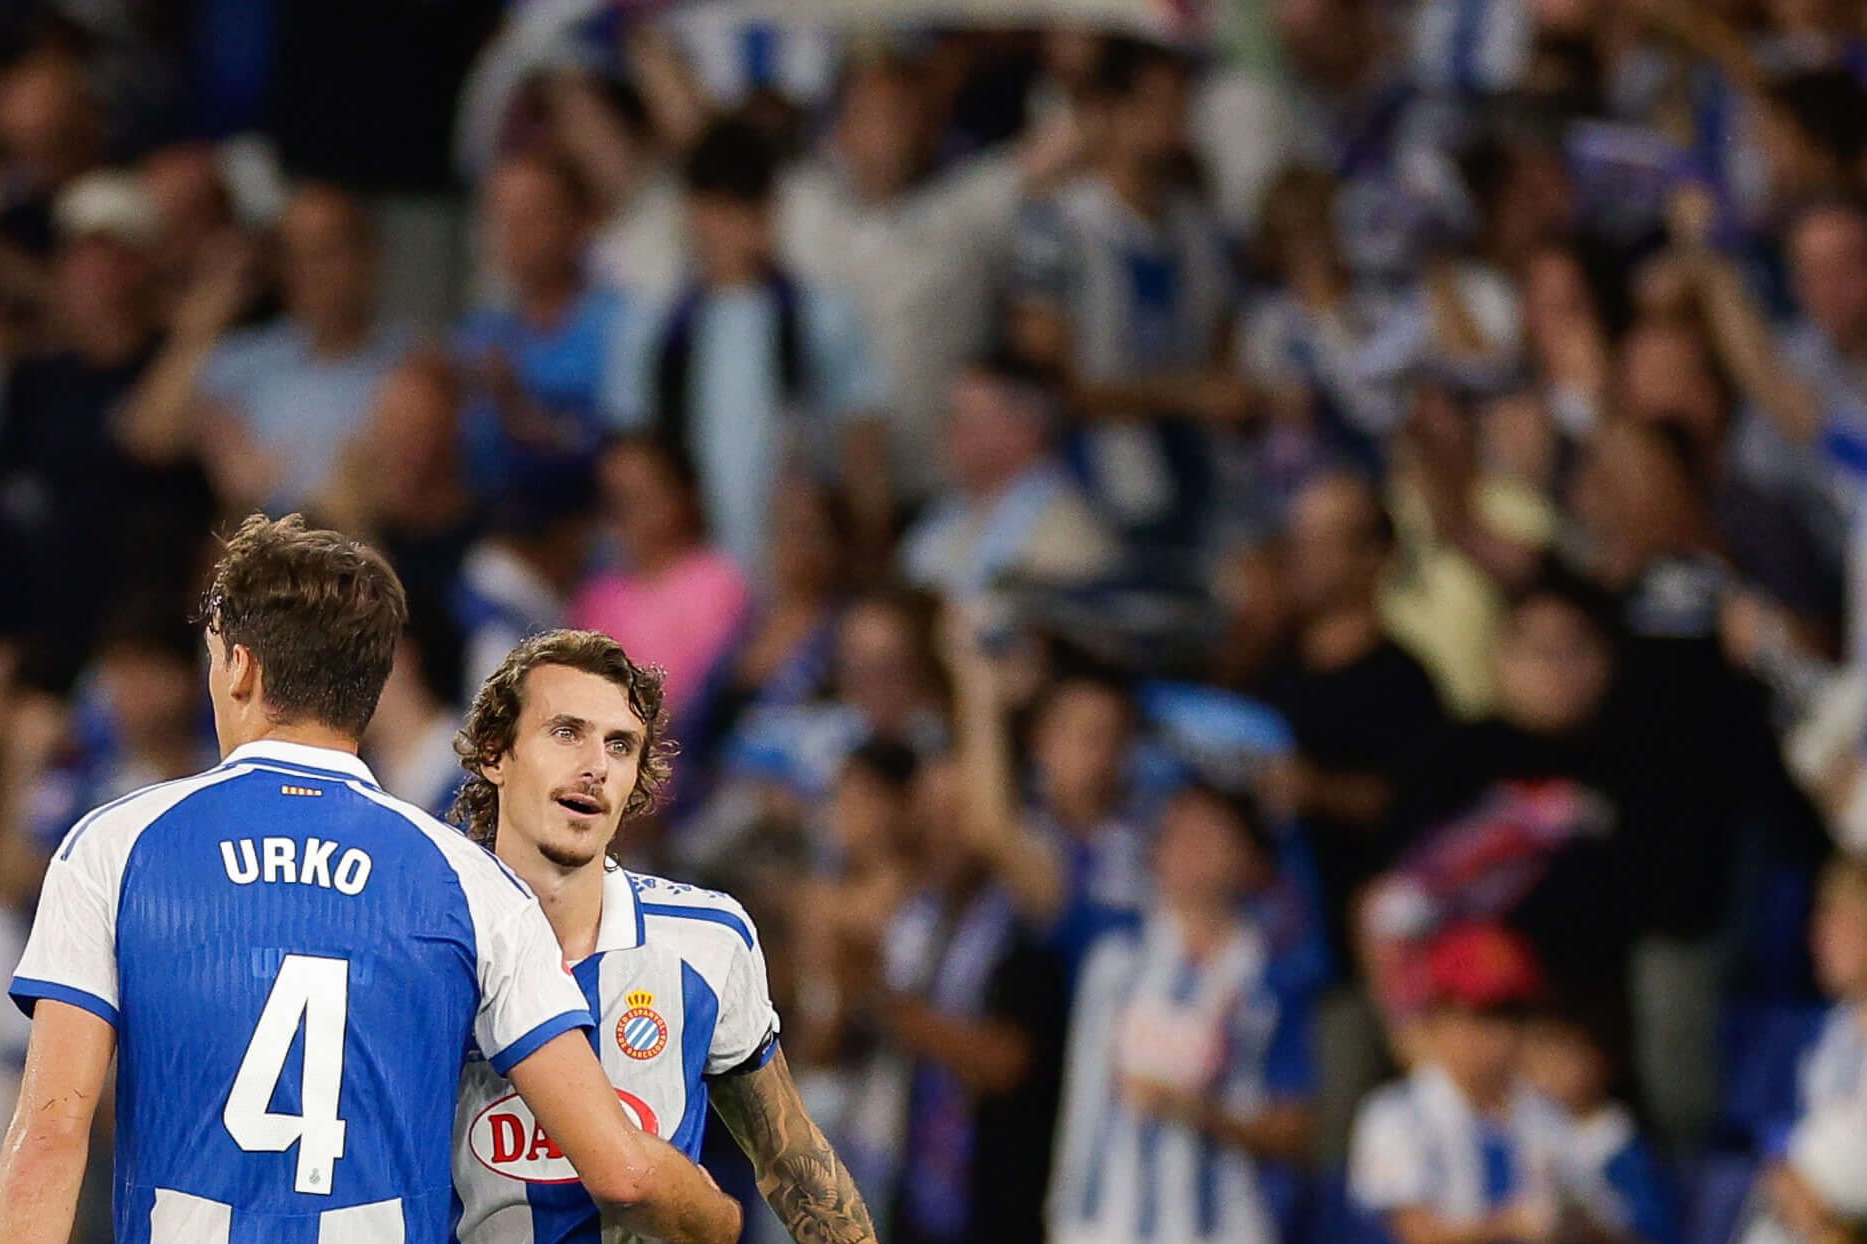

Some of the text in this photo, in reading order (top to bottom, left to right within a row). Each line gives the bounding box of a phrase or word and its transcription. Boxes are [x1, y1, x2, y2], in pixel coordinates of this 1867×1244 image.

[219, 836, 373, 897] URKO
[223, 954, 348, 1195] 4
[489, 1113, 566, 1164] DA
